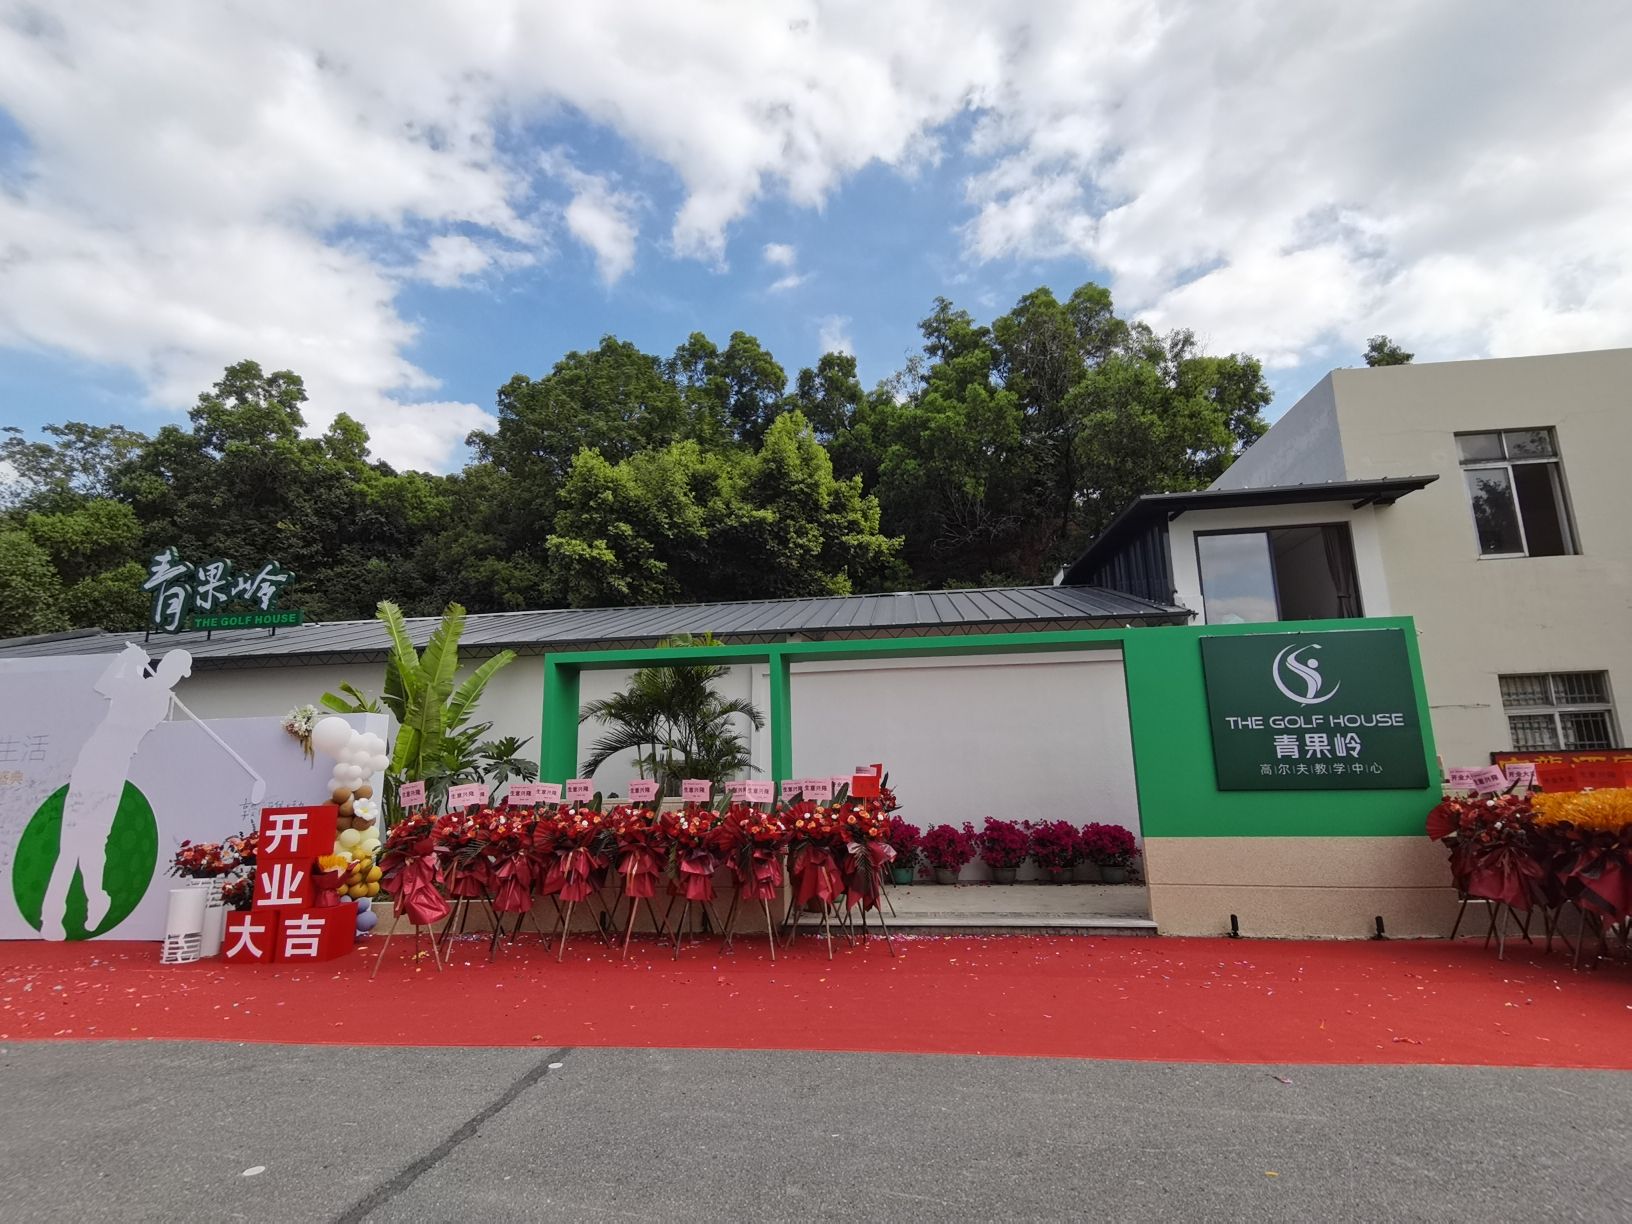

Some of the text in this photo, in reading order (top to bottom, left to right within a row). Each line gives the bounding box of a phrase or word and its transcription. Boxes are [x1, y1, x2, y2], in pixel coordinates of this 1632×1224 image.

[143, 549, 289, 632] 青果岭
[195, 614, 297, 627] THE GOLF HOUSE
[1225, 713, 1405, 729] THE GOLF HOUSE
[1273, 733, 1362, 759] 青果岭
[264, 813, 309, 854] 开
[257, 862, 303, 906] 业
[225, 914, 326, 959] 大吉
